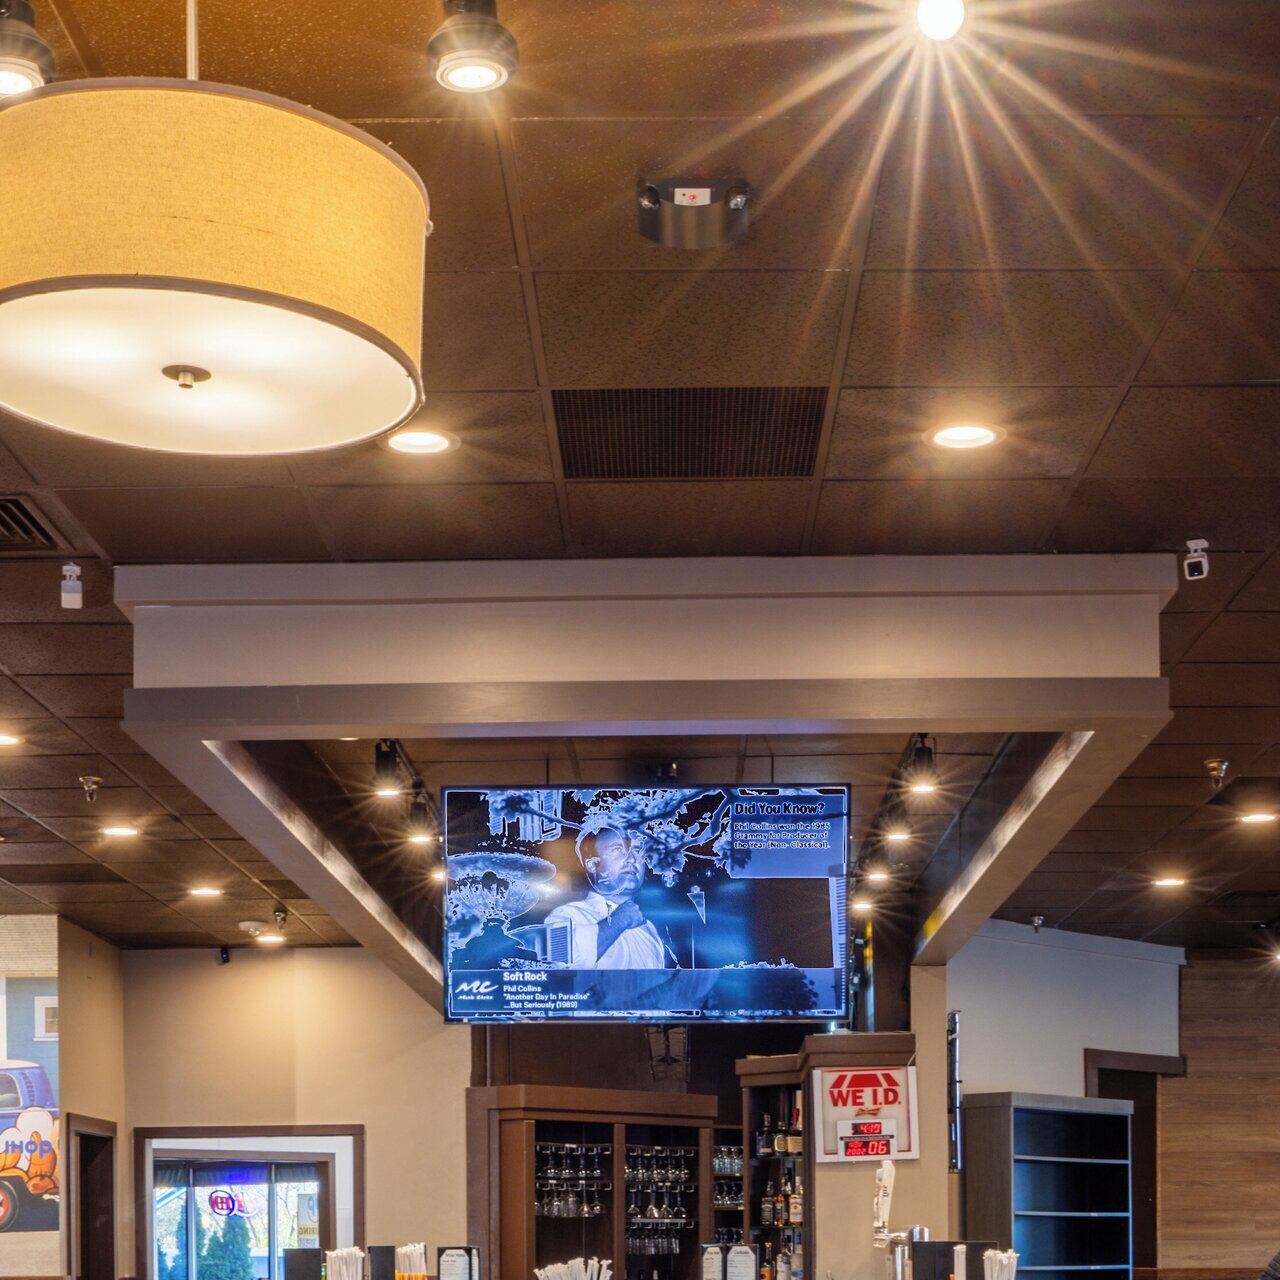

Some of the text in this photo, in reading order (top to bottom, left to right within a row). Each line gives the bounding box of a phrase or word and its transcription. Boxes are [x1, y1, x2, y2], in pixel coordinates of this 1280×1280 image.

[735, 802, 825, 814] Did You Know?
[503, 971, 547, 981] Soft Rock
[535, 993, 549, 1001] Day
[558, 992, 590, 1000] Paradise"
[523, 1001, 555, 1009] Seriously
[556, 1001, 577, 1009] (1989)
[829, 1087, 901, 1107] WE I.D.
[868, 1141, 887, 1155] 06
